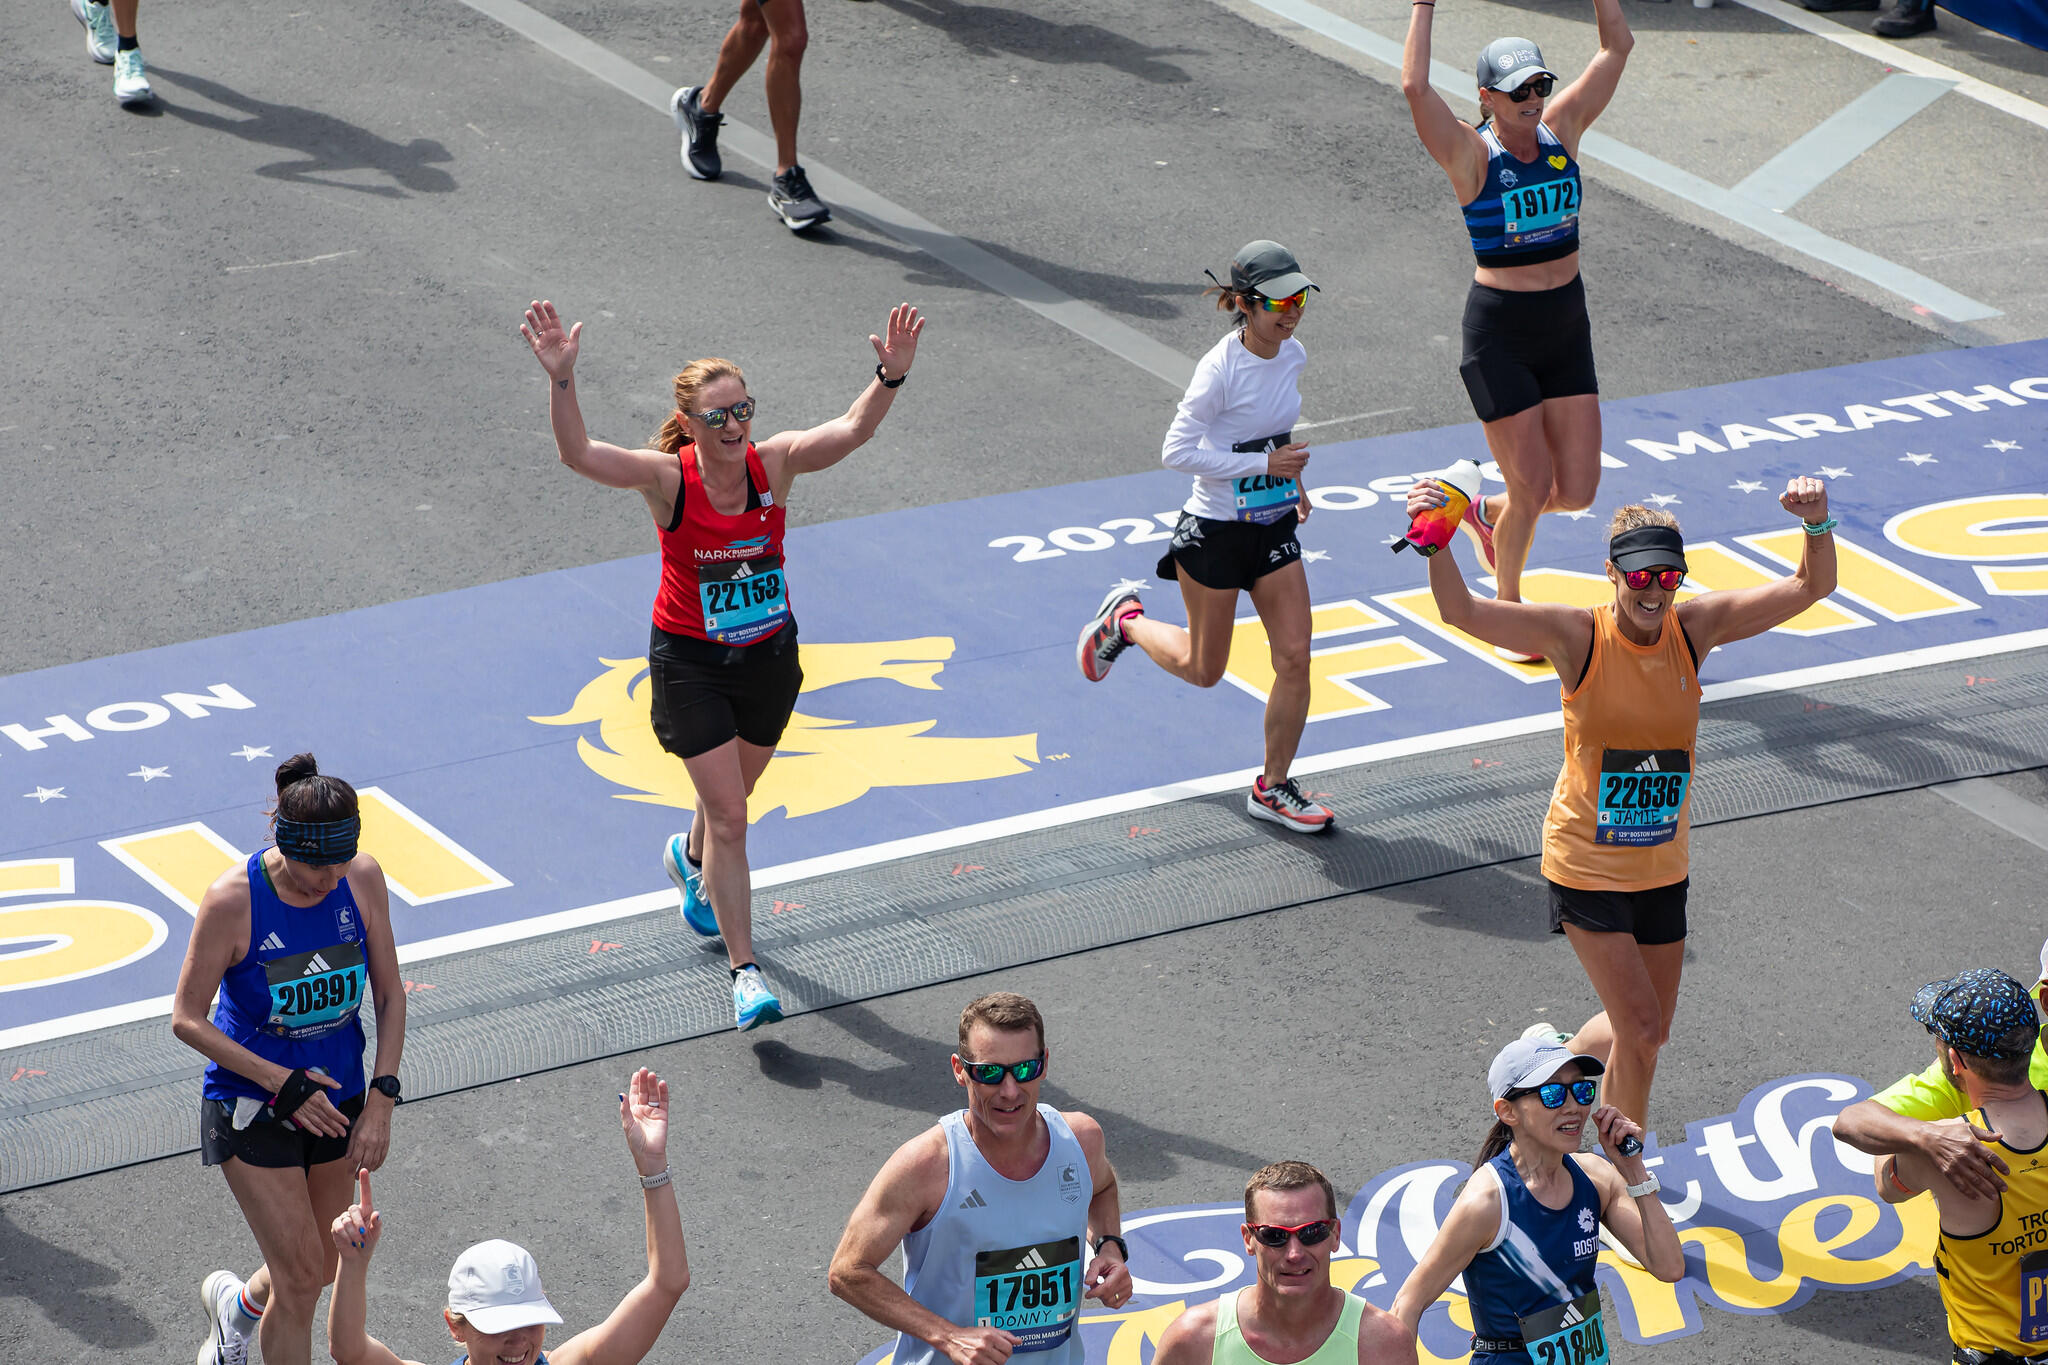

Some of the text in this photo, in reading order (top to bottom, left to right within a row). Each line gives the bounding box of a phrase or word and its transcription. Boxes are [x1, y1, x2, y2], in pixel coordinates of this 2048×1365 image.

[1510, 181, 1575, 219] 19172
[694, 545, 764, 560] NARK RUNNING
[1280, 541, 1299, 556] T8
[706, 574, 780, 614] 22153
[739, 626, 758, 636] BOSTON
[1605, 775, 1682, 809] 22636
[1613, 808, 1662, 825] JAMIE
[278, 970, 357, 1016] 20391
[986, 1266, 1072, 1314] 17951
[994, 1310, 1053, 1329] DONNY
[1537, 1318, 1604, 1365] 21840
